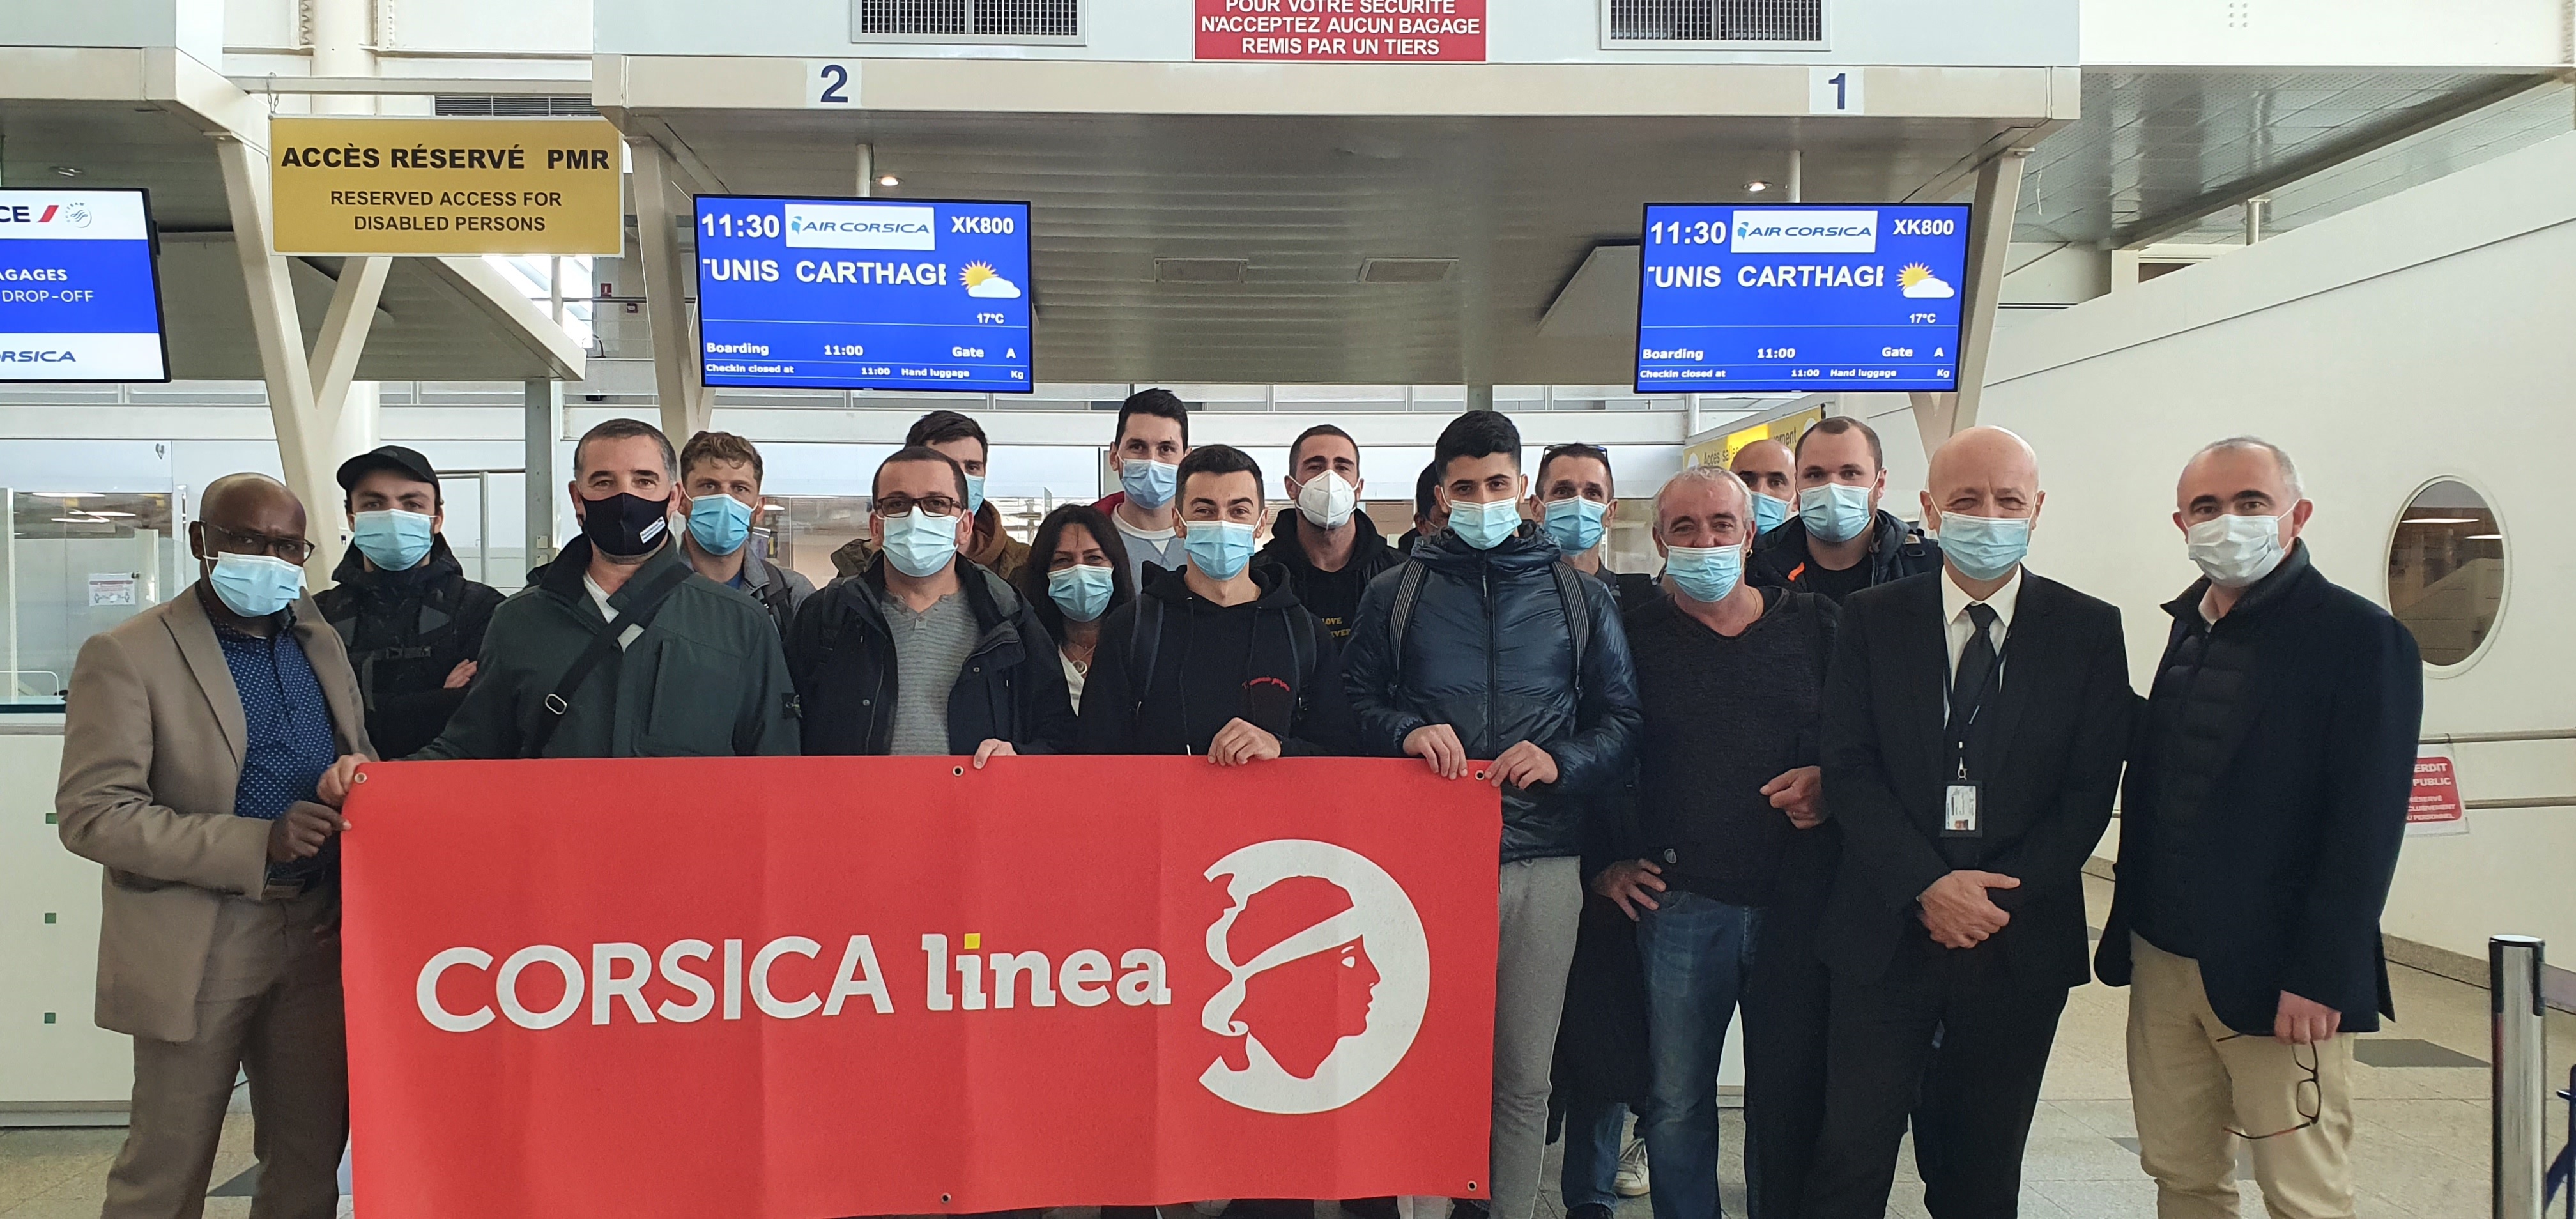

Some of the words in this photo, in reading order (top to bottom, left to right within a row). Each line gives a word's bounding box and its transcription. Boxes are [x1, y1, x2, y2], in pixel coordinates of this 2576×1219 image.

[1226, 0, 1281, 12] POUR
[1287, 0, 1354, 13] VOTRE
[1202, 15, 1321, 33] N'ACCEPTEZ
[1326, 17, 1393, 34] AUCUN
[1399, 17, 1480, 34] BAGAGE
[1242, 37, 1302, 54] REMIS
[1308, 38, 1347, 54] PAR
[1353, 38, 1379, 54] UN
[1384, 38, 1439, 55] TIERS
[820, 64, 848, 103] 2
[1828, 73, 1846, 110] 1
[280, 142, 380, 169] ACCÈS
[390, 143, 525, 169] RÉSERVÉ
[548, 149, 610, 169] PMR
[331, 190, 433, 206] RESERVED
[439, 191, 517, 206] ACCESS
[523, 192, 562, 206] FOR
[355, 215, 449, 231] DISABLED
[456, 216, 546, 231] PERSONS
[702, 213, 780, 238] 11:30
[802, 222, 836, 231] AIR
[839, 222, 930, 234] CORSICA
[951, 216, 1014, 234] XK800
[1892, 219, 1954, 236] XK800
[1650, 221, 1726, 244] 11:30
[1748, 227, 1782, 236] AIR
[1785, 227, 1872, 236] CORSICA
[1, 290, 93, 302] DROP-OFF
[706, 342, 769, 356] Boarding
[824, 344, 864, 356] 11:00
[952, 346, 985, 358] Gate
[1006, 348, 1016, 358] A
[1643, 348, 1704, 361] Boarding
[1757, 348, 1796, 358] 11:00
[1882, 346, 1913, 357] Gate
[1933, 347, 1944, 357] A
[0, 351, 76, 362] RSICA
[705, 364, 746, 372] Checkin
[748, 364, 781, 373] closed
[783, 365, 795, 374] at
[861, 367, 891, 376] 11:00
[901, 367, 927, 376] Hand
[930, 368, 970, 379] luggage
[1011, 370, 1024, 380] Kg
[1639, 369, 1679, 378] Checkin
[1681, 369, 1713, 378] closed
[1791, 369, 1820, 377] 11:00
[1830, 369, 1856, 377] Hand
[1858, 369, 1897, 378] luggage
[1936, 369, 1950, 378] Kg
[2413, 777, 2451, 786] PUBLIC
[416, 934, 894, 1032] CORSICA
[921, 933, 1172, 1011] linea
